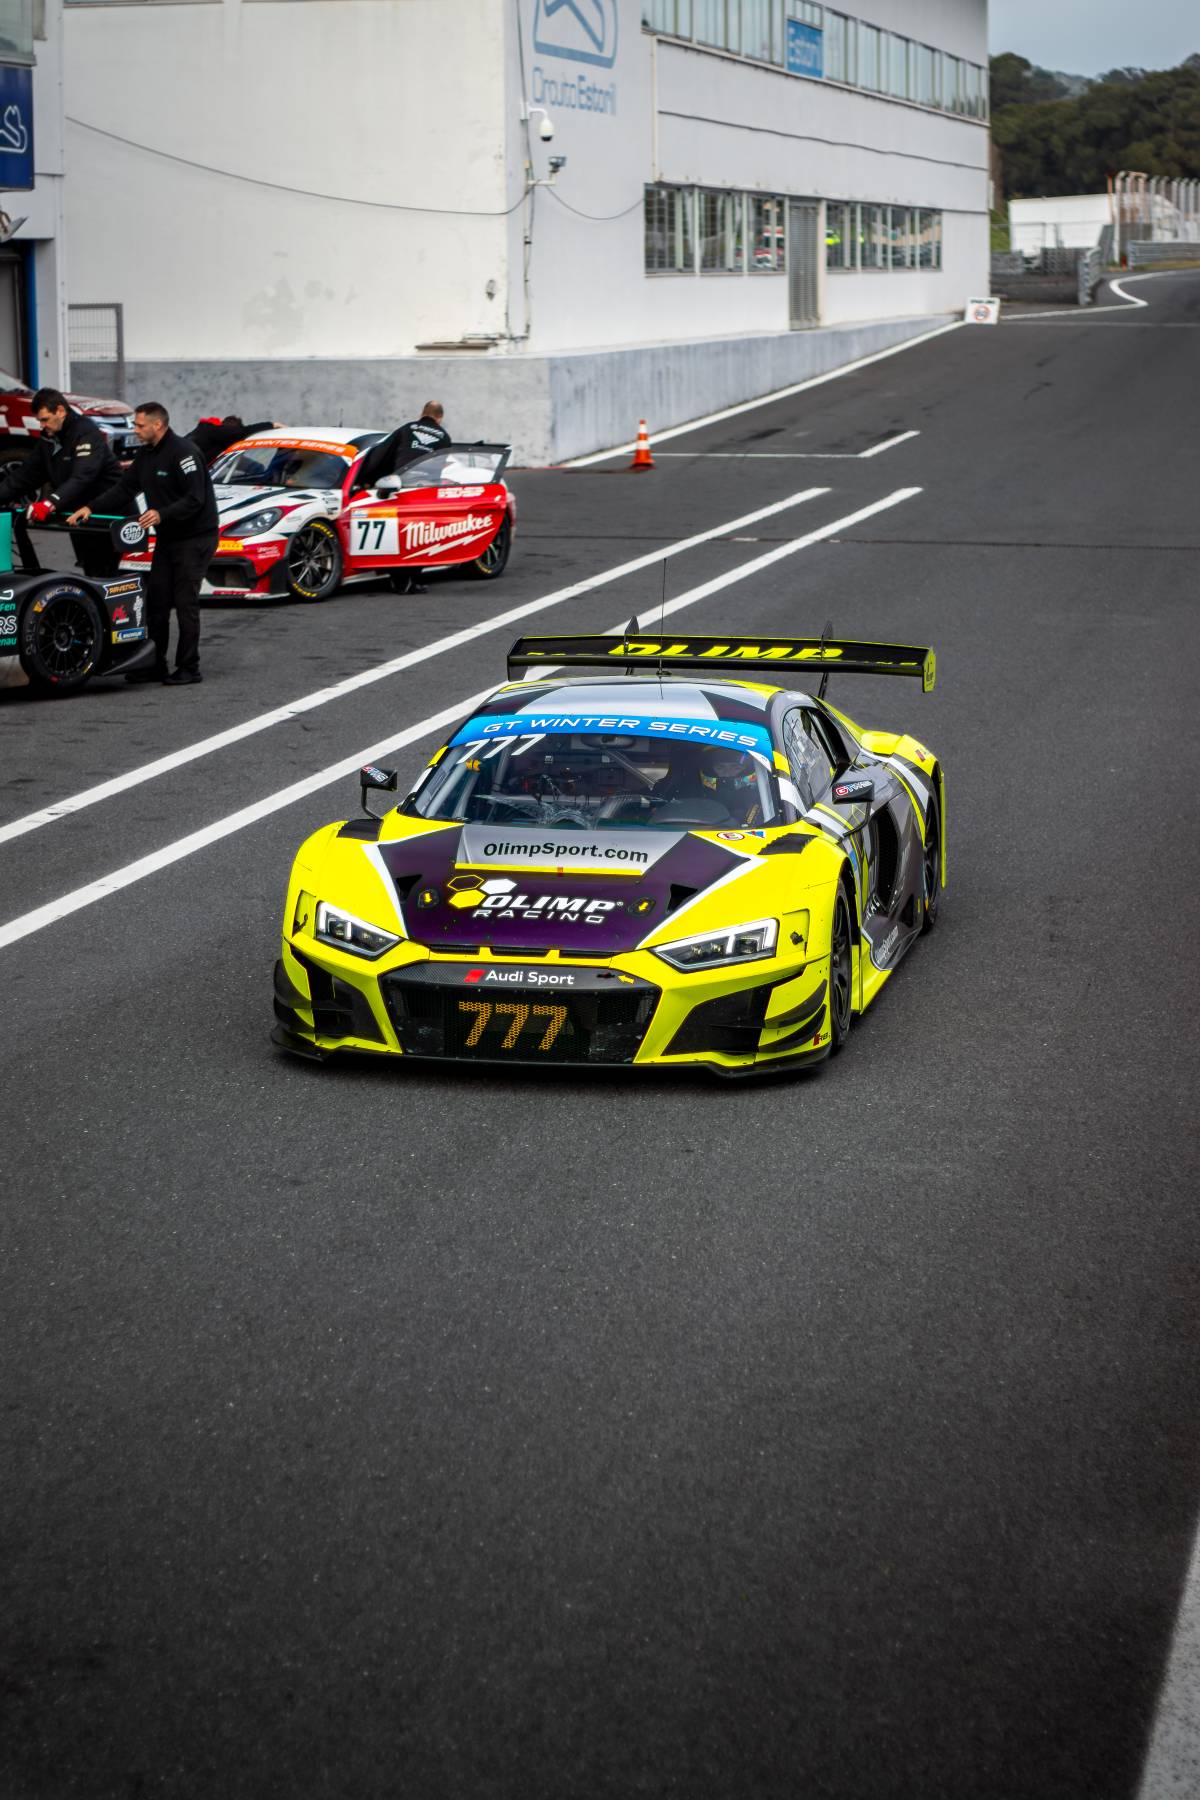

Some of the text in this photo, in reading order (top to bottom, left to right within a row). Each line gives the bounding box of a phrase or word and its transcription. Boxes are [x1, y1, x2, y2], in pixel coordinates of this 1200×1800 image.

[358, 520, 386, 550] 77
[401, 513, 493, 551] Milwaukee
[608, 643, 843, 661] OLIMP
[483, 718, 758, 747] GT WINTER SERIES
[456, 734, 546, 765] 777
[483, 842, 649, 863] OlimpSport.com
[472, 909, 605, 924] RACING
[481, 895, 616, 914] OLIMP
[485, 970, 575, 986] Audi Sport
[458, 1001, 568, 1050] 777
